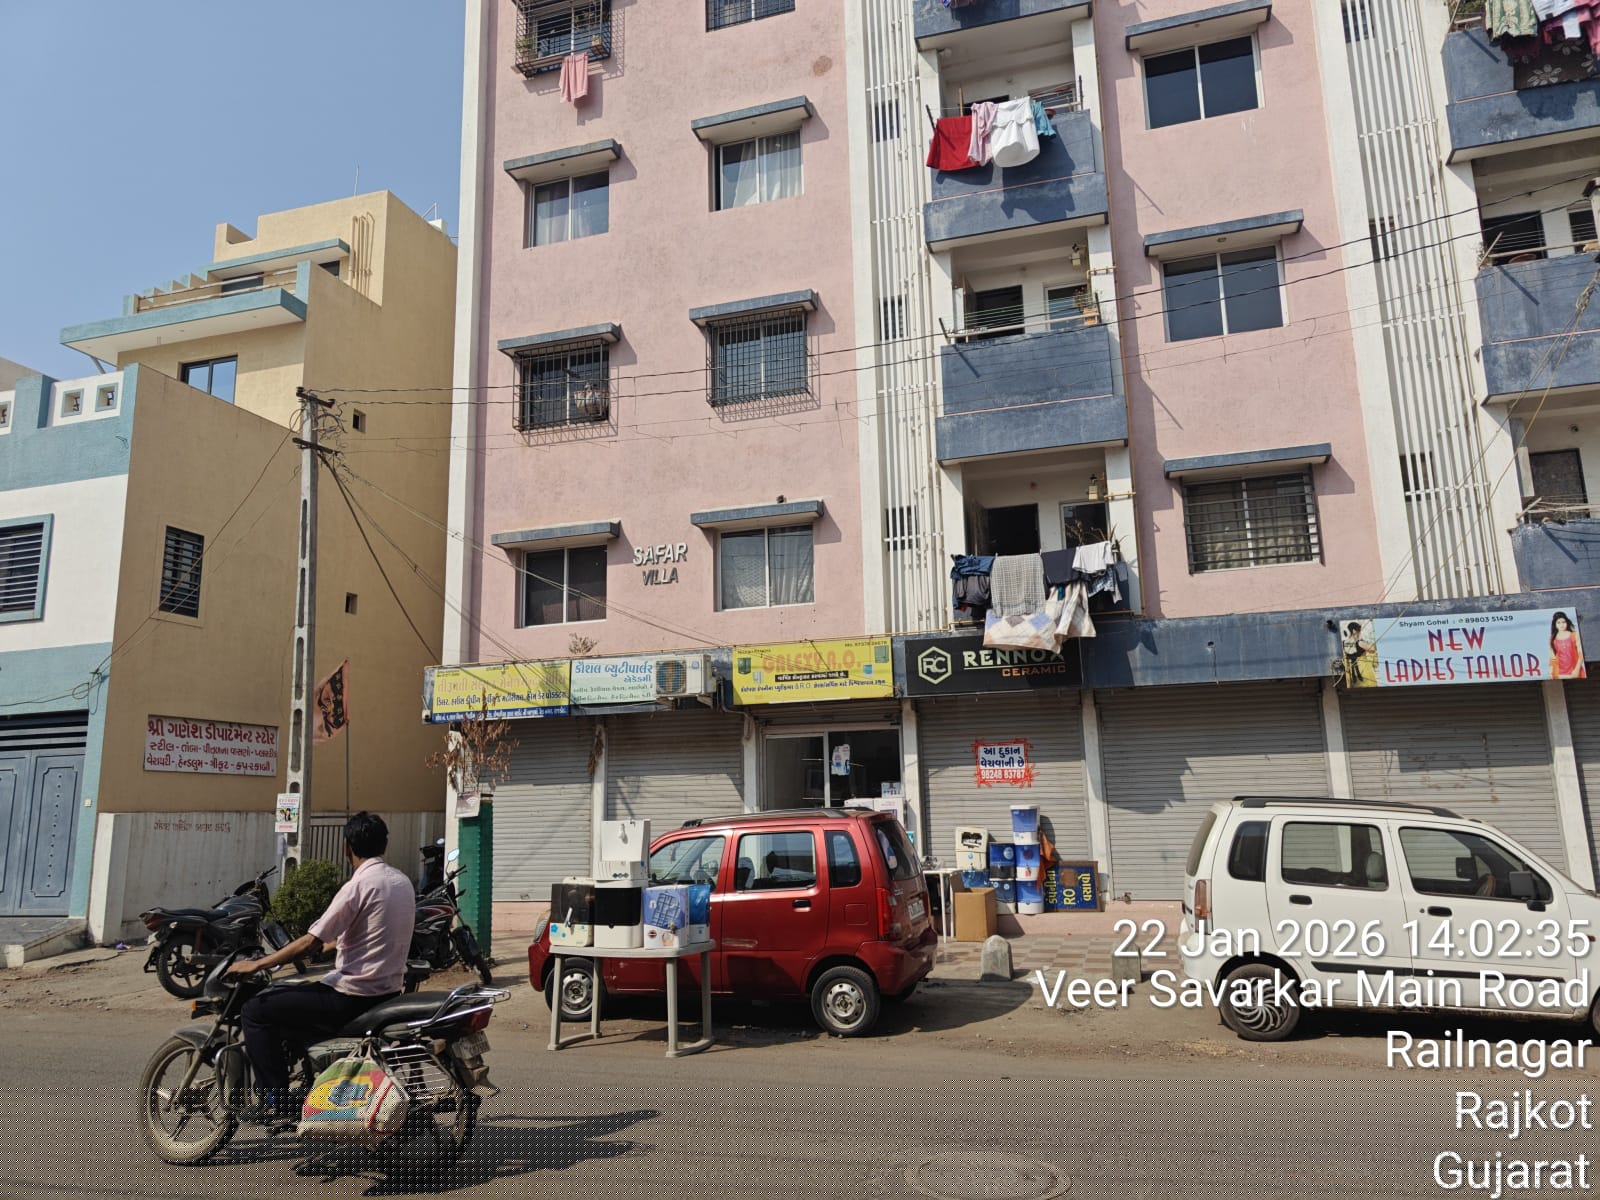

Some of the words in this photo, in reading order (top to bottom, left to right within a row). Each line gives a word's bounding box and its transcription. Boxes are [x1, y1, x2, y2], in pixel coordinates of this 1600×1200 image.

[633, 542, 688, 567] SAFAR
[642, 567, 679, 586] VILLA
[1399, 619, 1425, 628] Shyam
[1491, 615, 1514, 623] 51429
[1428, 627, 1485, 652] NEW
[1001, 665, 1066, 677] CERAMIC
[1385, 658, 1455, 682] LADIES
[1463, 653, 1541, 680] TAILOR
[148, 718, 164, 736] શ્રી
[167, 720, 202, 740] ગણેશ
[1062, 888, 1077, 905] RO
